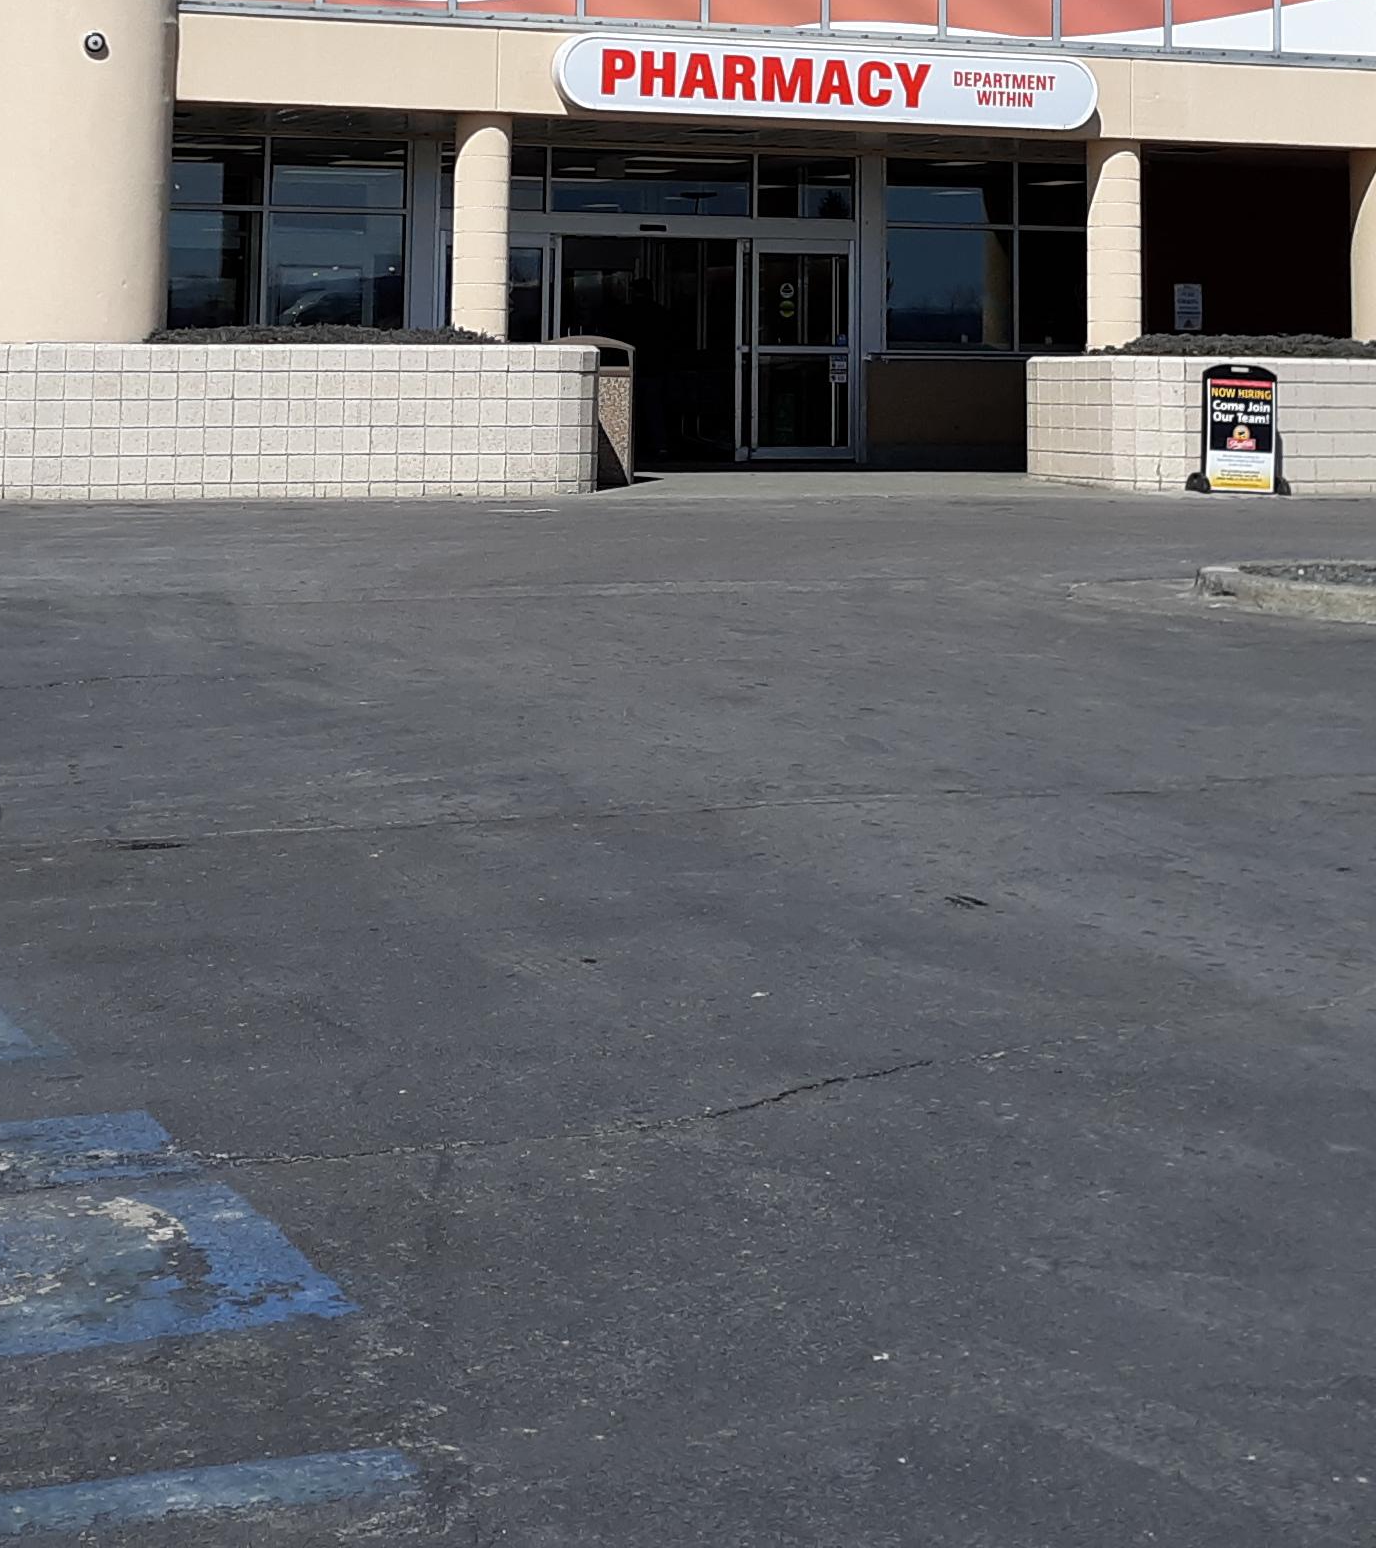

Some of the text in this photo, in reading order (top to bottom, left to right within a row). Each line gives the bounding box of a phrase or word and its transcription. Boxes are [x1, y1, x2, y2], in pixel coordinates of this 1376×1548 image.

[601, 48, 931, 109] PHARMACY
[953, 71, 1056, 91] DEPARTMENT
[977, 90, 1033, 107] WITHIN
[1211, 388, 1272, 400] NOW HIRING
[1212, 400, 1271, 413] Come Join
[1212, 412, 1270, 424] Our Team!
